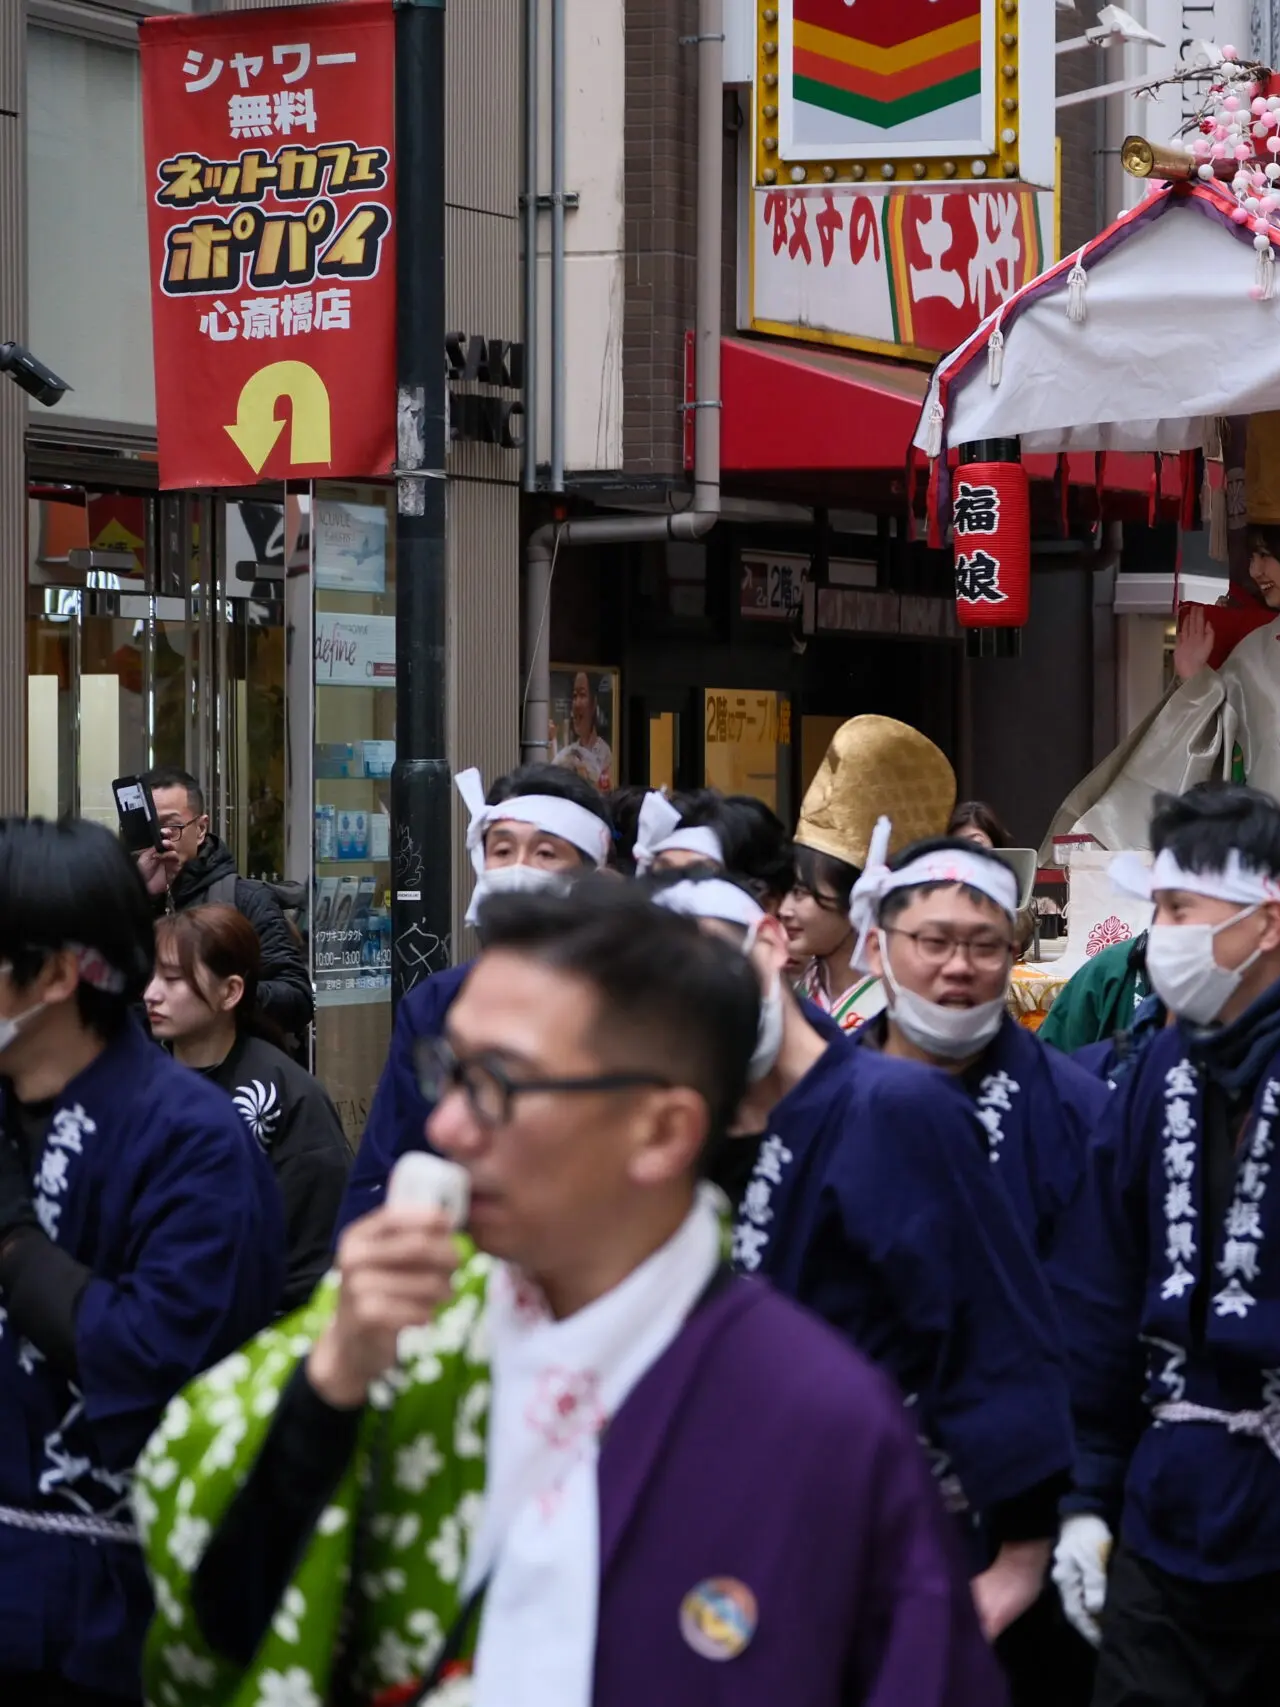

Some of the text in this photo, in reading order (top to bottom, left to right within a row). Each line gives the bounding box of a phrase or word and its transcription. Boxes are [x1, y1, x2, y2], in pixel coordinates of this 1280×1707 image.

[182, 43, 356, 92] シャワー
[227, 88, 317, 139] 無料
[160, 144, 384, 204] ネットカフェ
[164, 203, 384, 290] ポパイ
[199, 288, 351, 341] 心斎橋店
[954, 482, 1008, 604] 福娘
[314, 624, 357, 677] define
